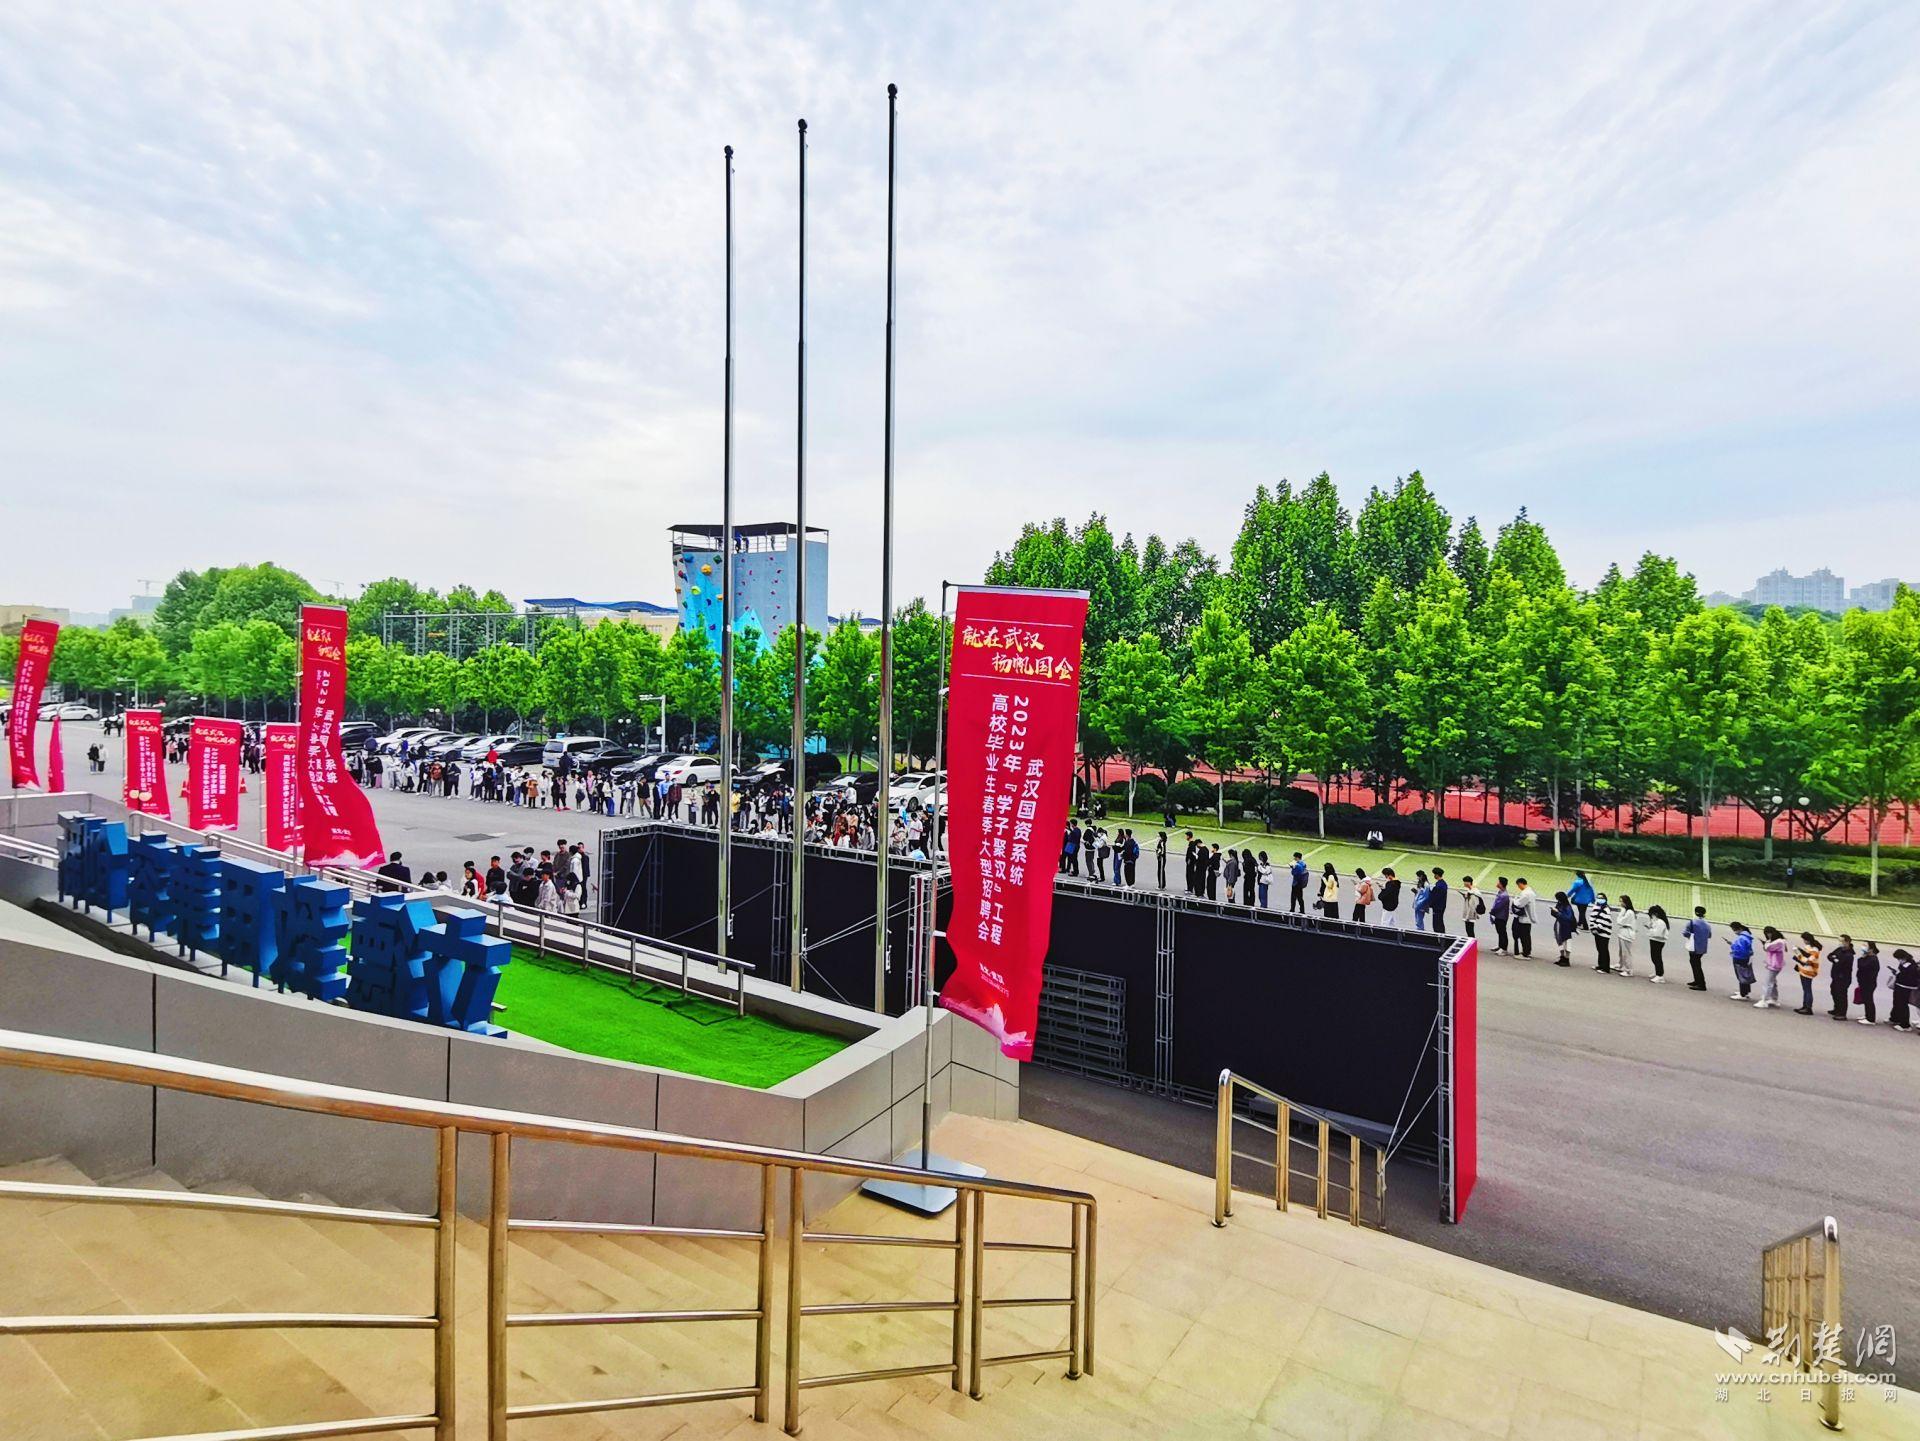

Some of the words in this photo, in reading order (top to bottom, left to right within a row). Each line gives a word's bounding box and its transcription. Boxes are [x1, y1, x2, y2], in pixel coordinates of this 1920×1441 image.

[962, 625, 1045, 653] 就在武汉
[992, 652, 1074, 680] 扬帆国企
[977, 693, 1010, 942] 高校毕业生春季大型招聘会
[1009, 758, 1045, 887] 武汉国资系统
